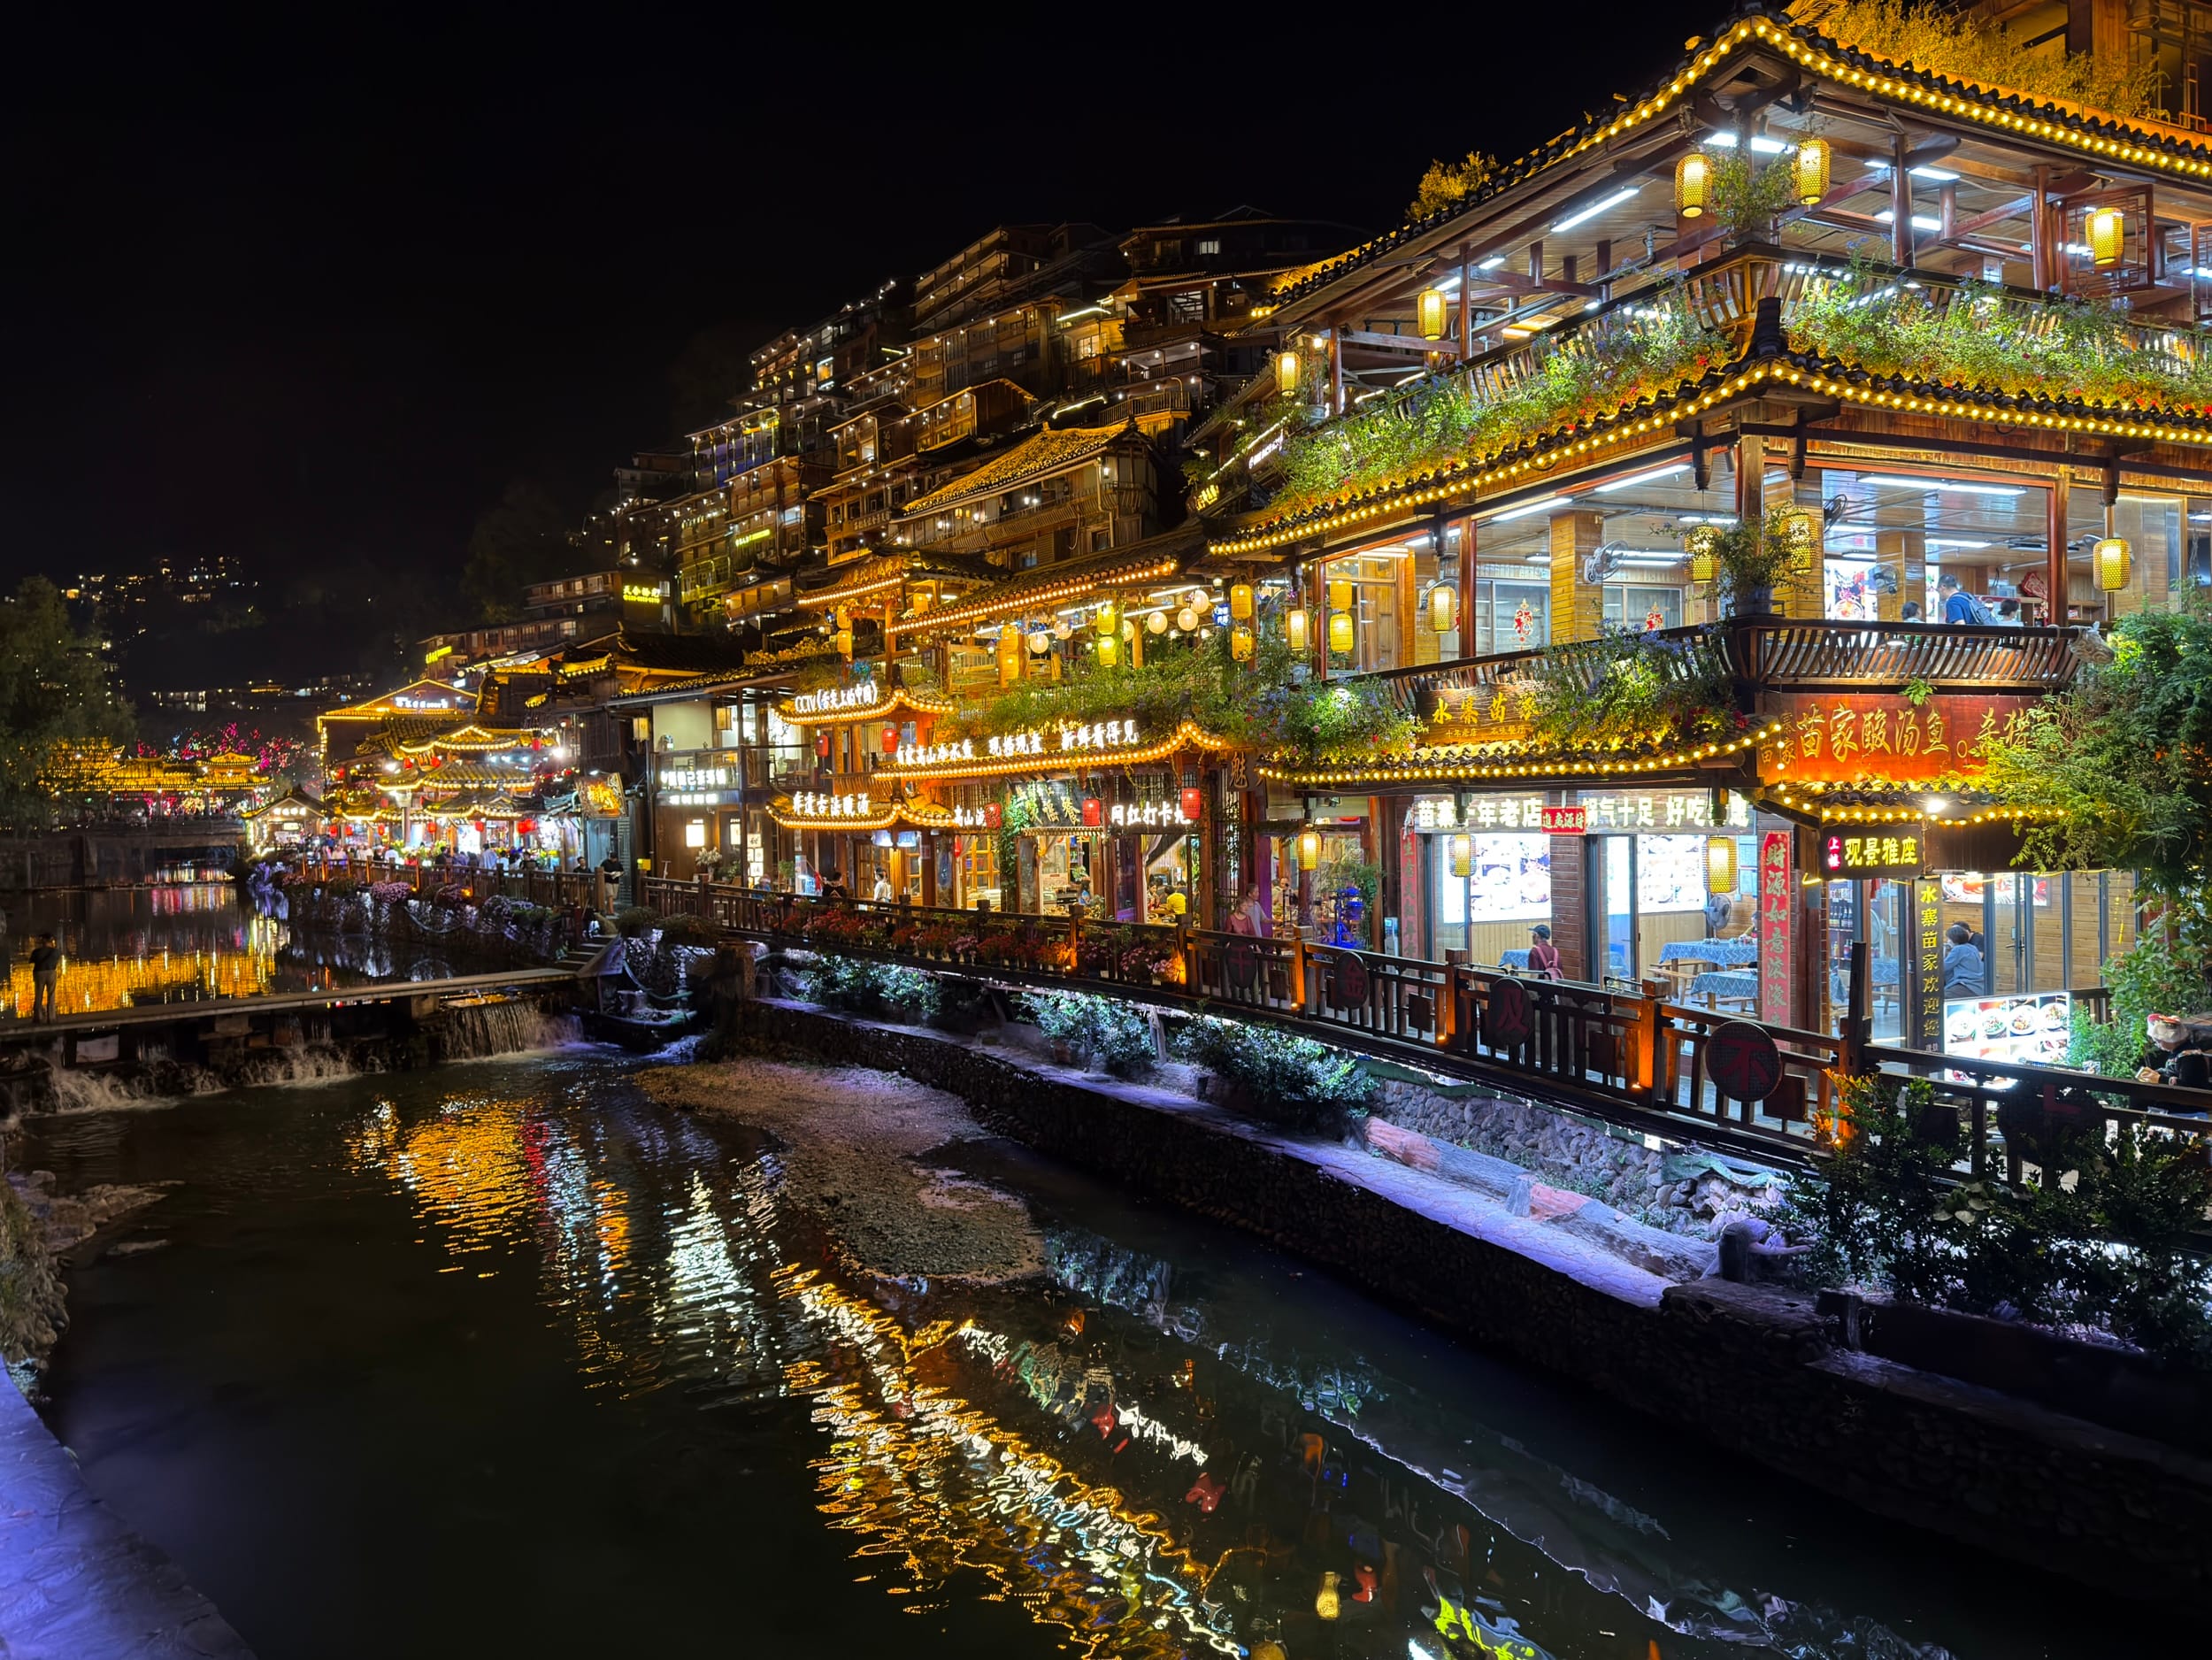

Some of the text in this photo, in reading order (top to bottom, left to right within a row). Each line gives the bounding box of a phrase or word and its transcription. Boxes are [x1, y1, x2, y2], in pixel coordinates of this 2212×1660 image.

[1445, 728, 1478, 738] 十年老店
[1796, 703, 1949, 763] 苗家酸汤鱼
[1665, 794, 1748, 827] 好吃惠
[1844, 836, 1918, 866] 观景雅座
[1920, 885, 1940, 1037] 水寨苗家欢迎您
[1718, 1037, 1768, 1092] 不
